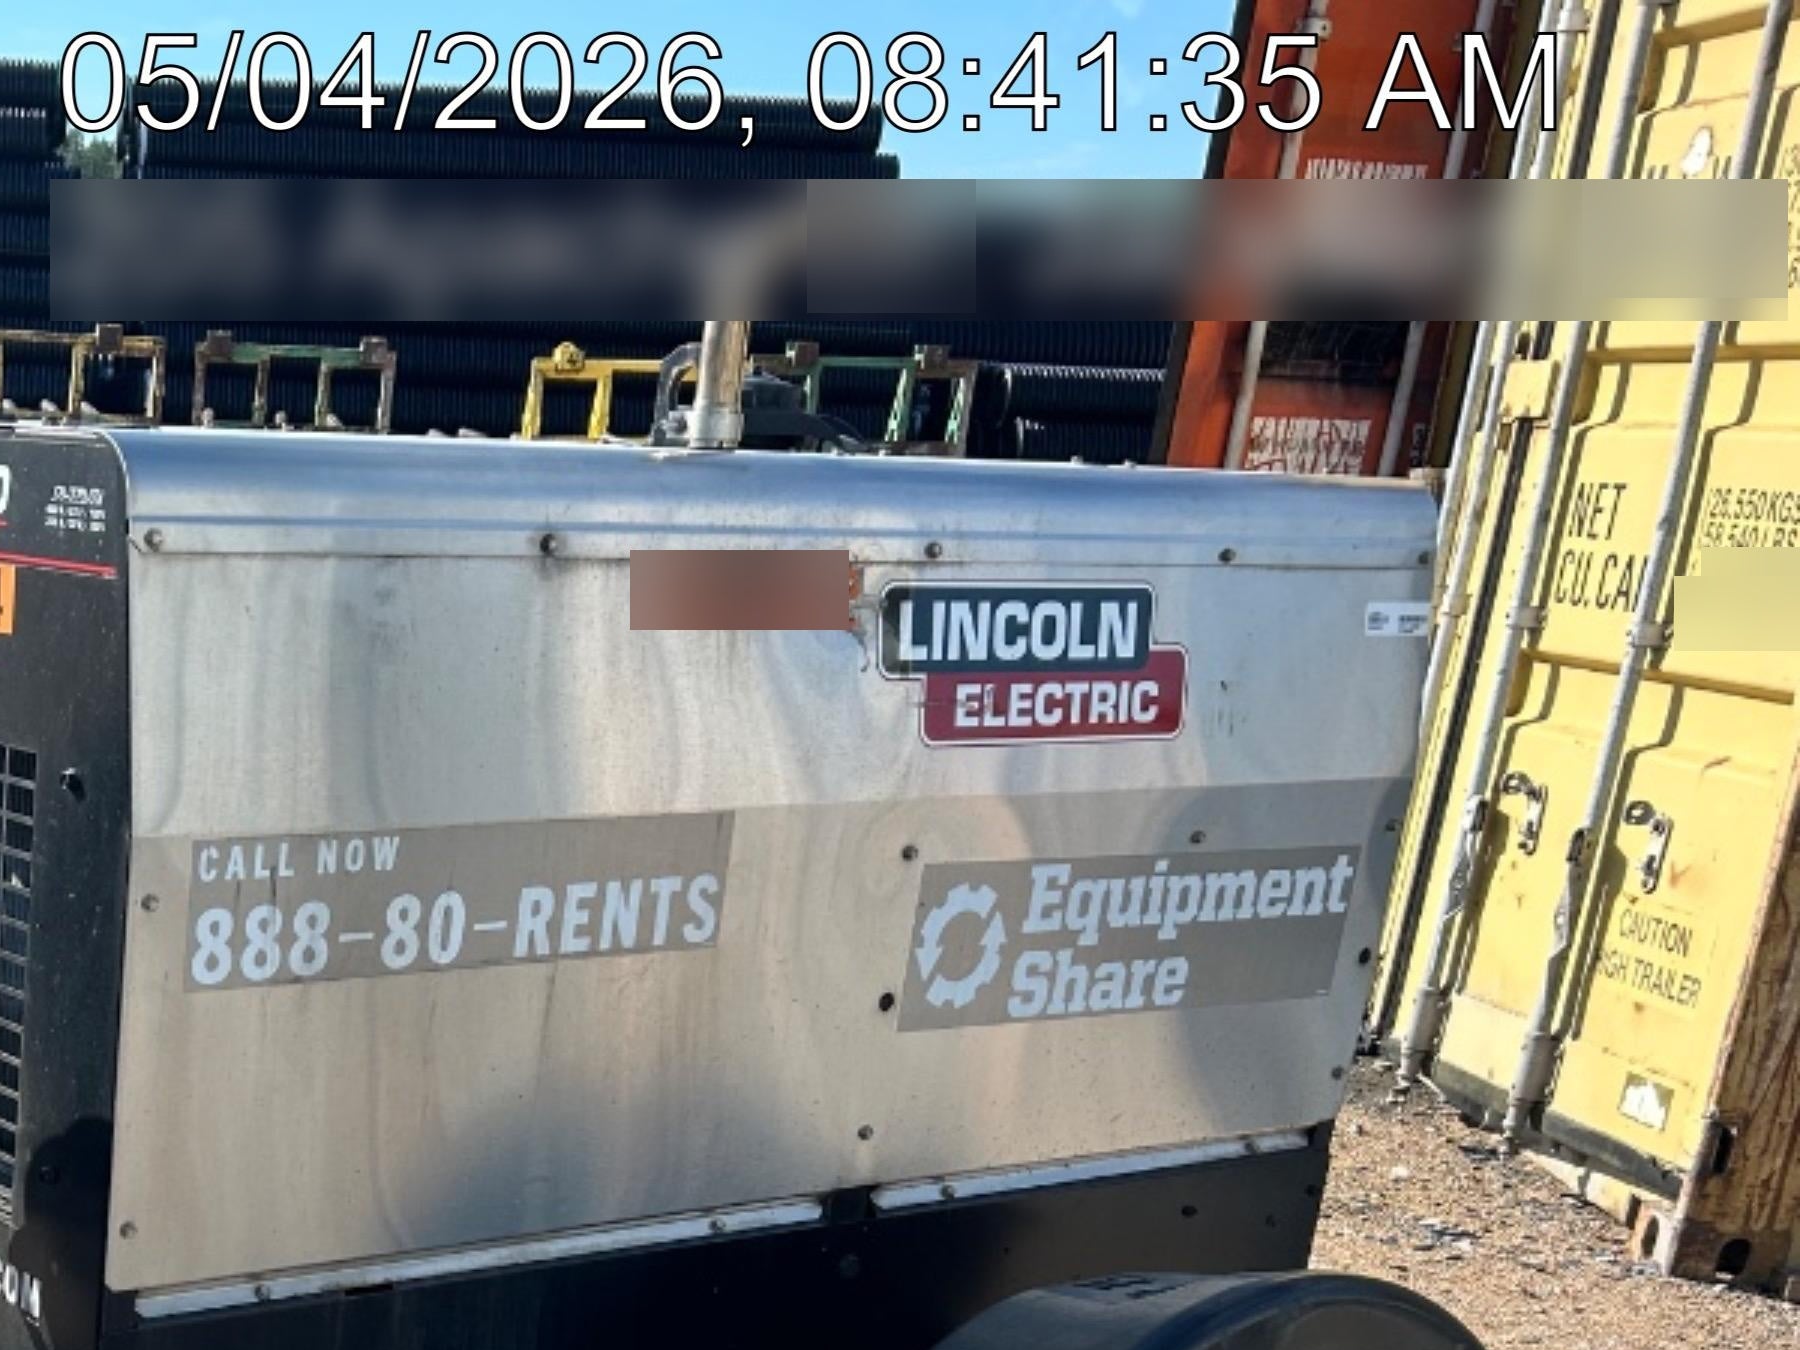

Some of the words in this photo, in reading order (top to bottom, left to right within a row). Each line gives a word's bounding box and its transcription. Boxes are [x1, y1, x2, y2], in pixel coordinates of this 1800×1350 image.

[1568, 482, 1628, 541] NET
[899, 601, 1138, 661] LINCOLN
[954, 680, 1160, 728] ELECTRIC
[199, 841, 294, 882] CALL
[316, 836, 400, 874] NOW
[191, 872, 720, 985] 888-80-RENTS
[1021, 854, 1355, 946] Equipment
[1619, 908, 1693, 958] CAUTION
[1007, 949, 1189, 1018] Share
[1632, 957, 1702, 1008] TRAILER
